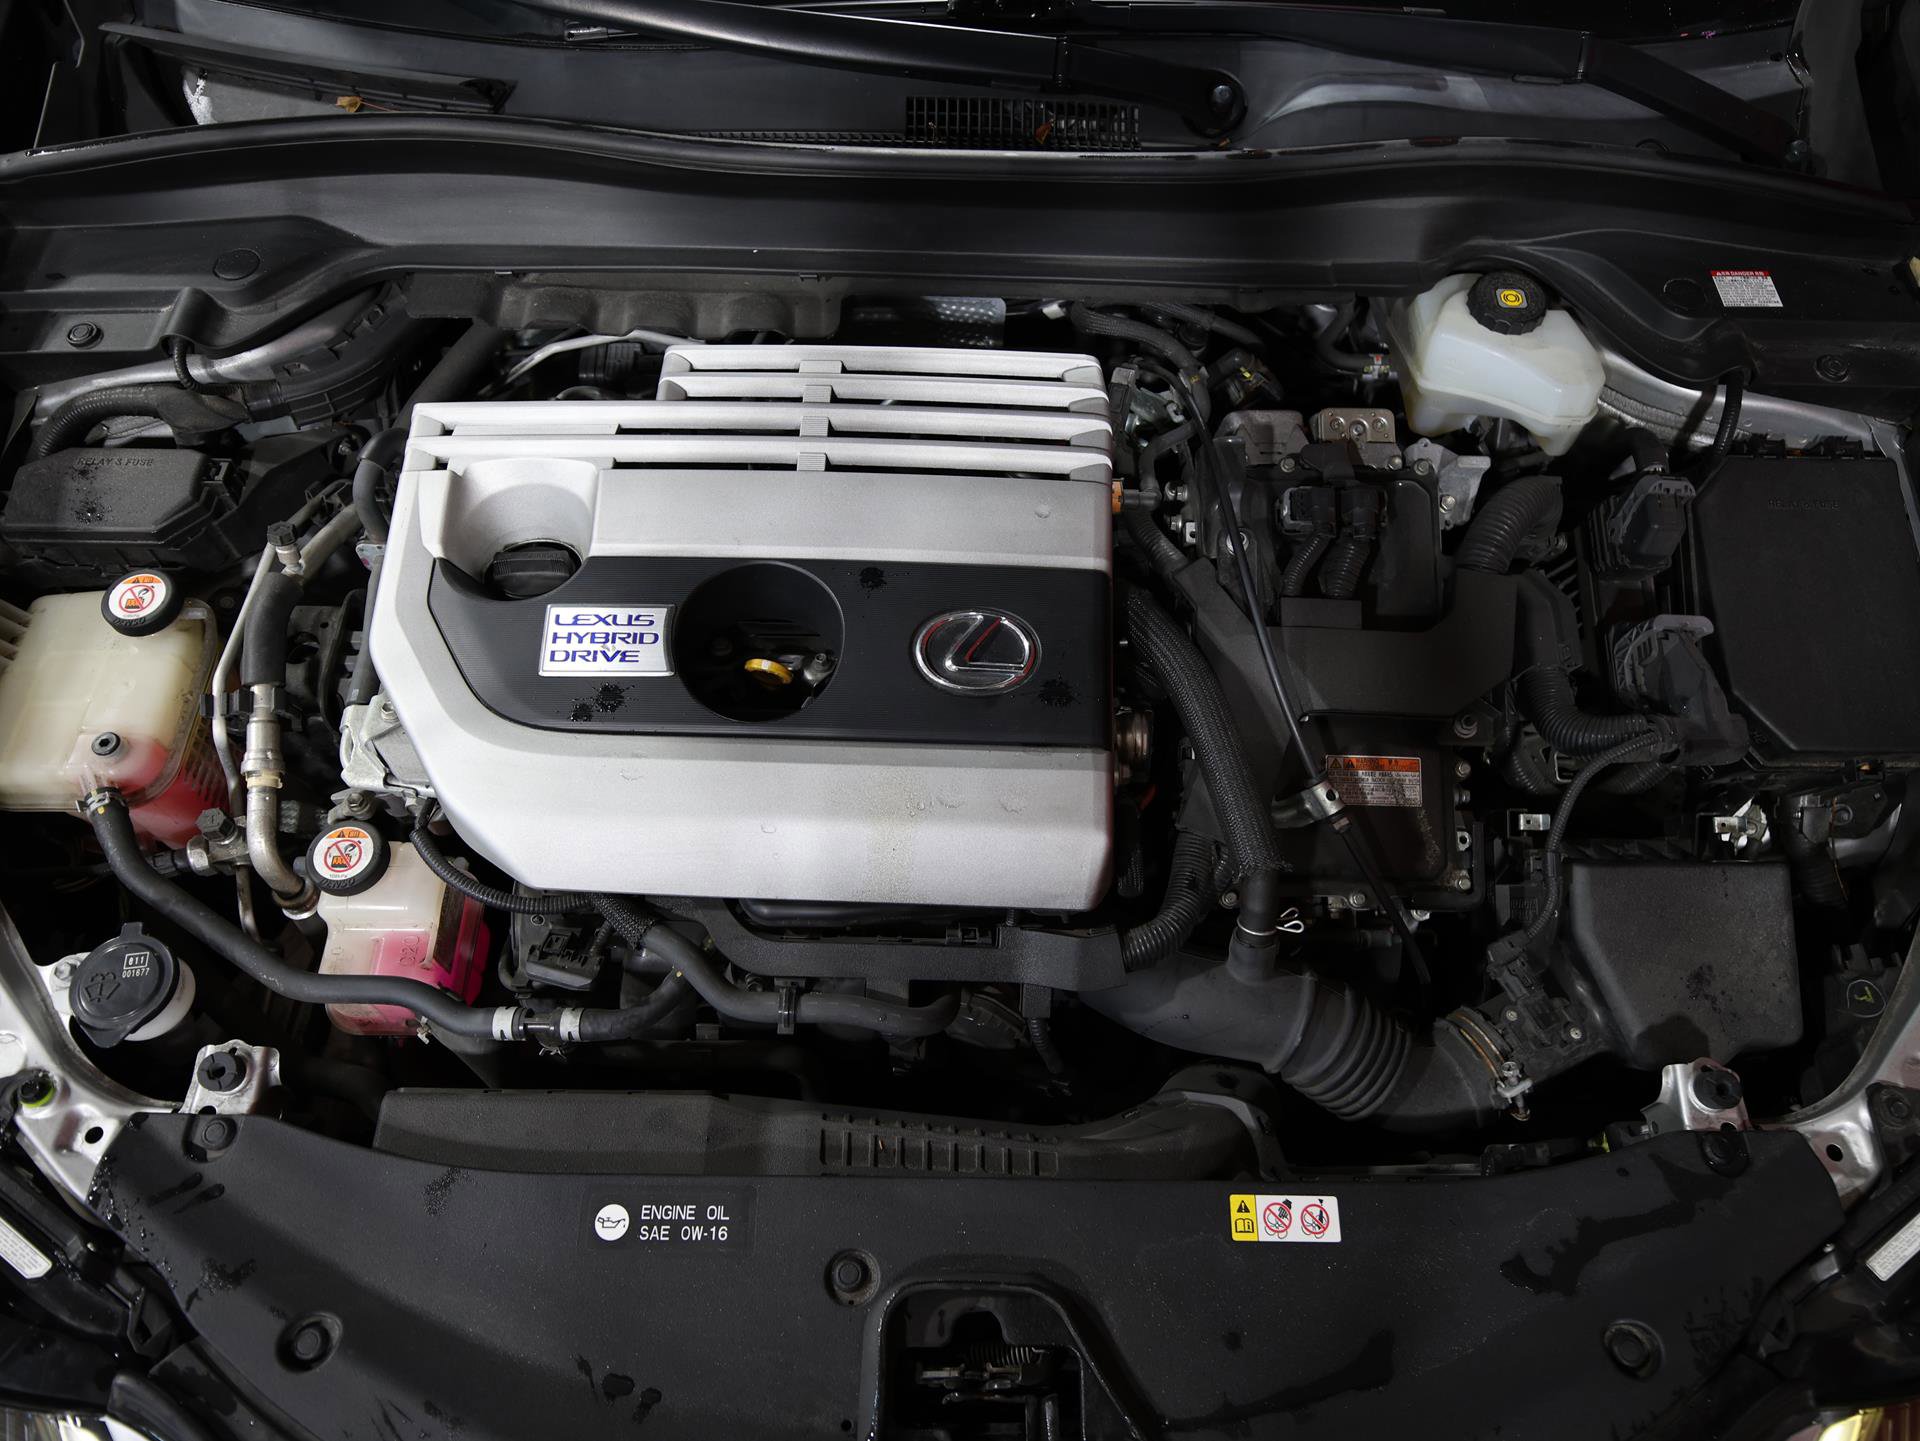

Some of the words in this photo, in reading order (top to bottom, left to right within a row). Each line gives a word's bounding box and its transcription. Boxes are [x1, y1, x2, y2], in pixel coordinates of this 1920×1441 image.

[555, 614, 655, 626] LEXUS
[552, 632, 660, 645] HYBRID
[549, 650, 641, 663] DRIVE
[641, 1204, 696, 1221] ENGINE
[706, 1205, 730, 1221] OIL
[639, 1225, 671, 1241] SAE
[680, 1225, 729, 1241] 0W-16
